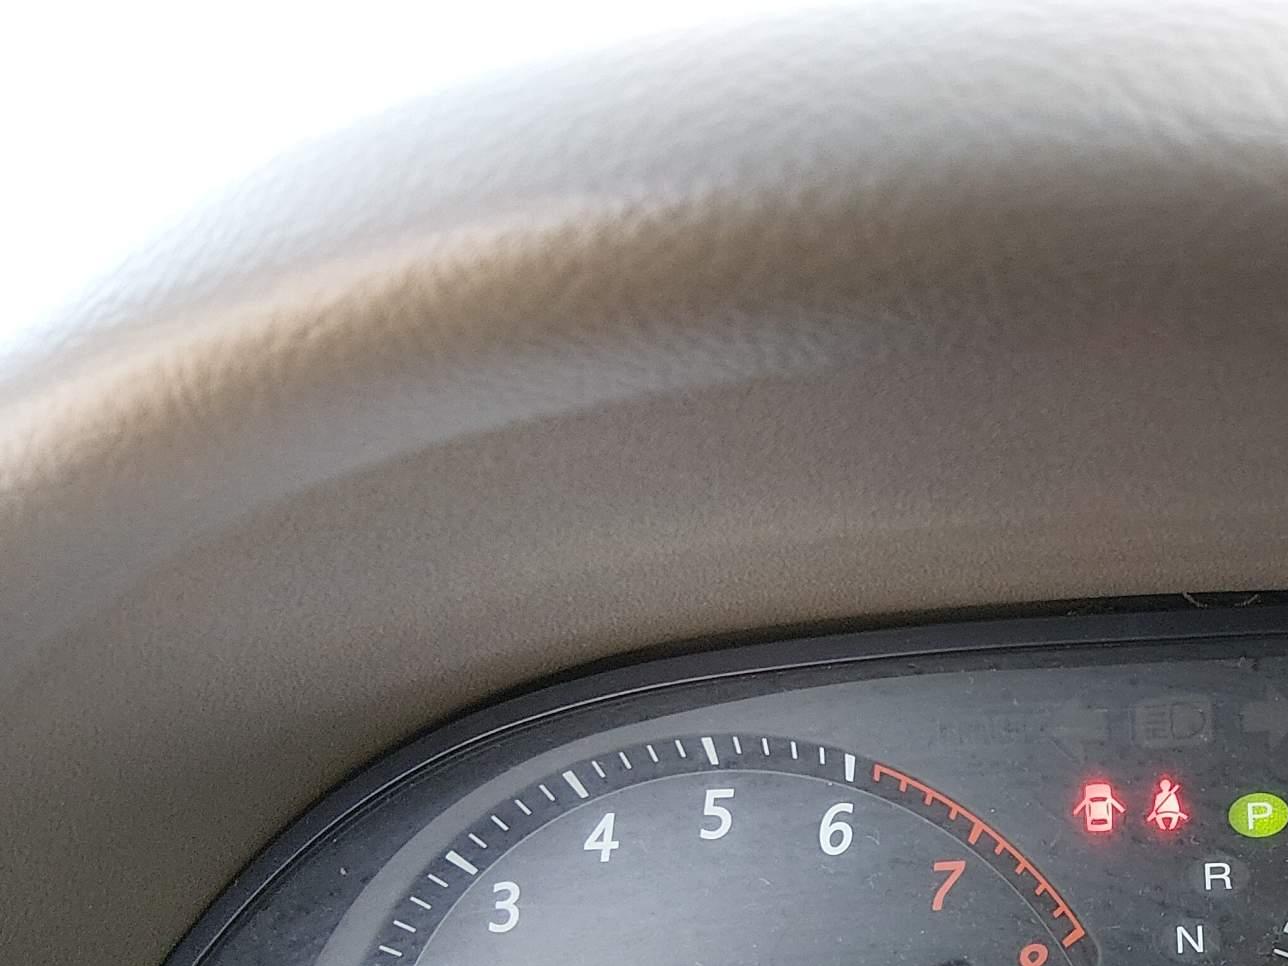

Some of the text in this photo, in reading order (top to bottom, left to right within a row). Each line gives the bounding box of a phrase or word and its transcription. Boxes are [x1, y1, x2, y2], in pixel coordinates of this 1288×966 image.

[584, 813, 619, 862] 4
[700, 789, 734, 839] 5
[820, 803, 853, 855] 6
[1247, 802, 1273, 830] P
[933, 861, 965, 910] 7
[1205, 863, 1231, 890] R
[489, 881, 519, 932] 3
[1177, 926, 1203, 953] N
